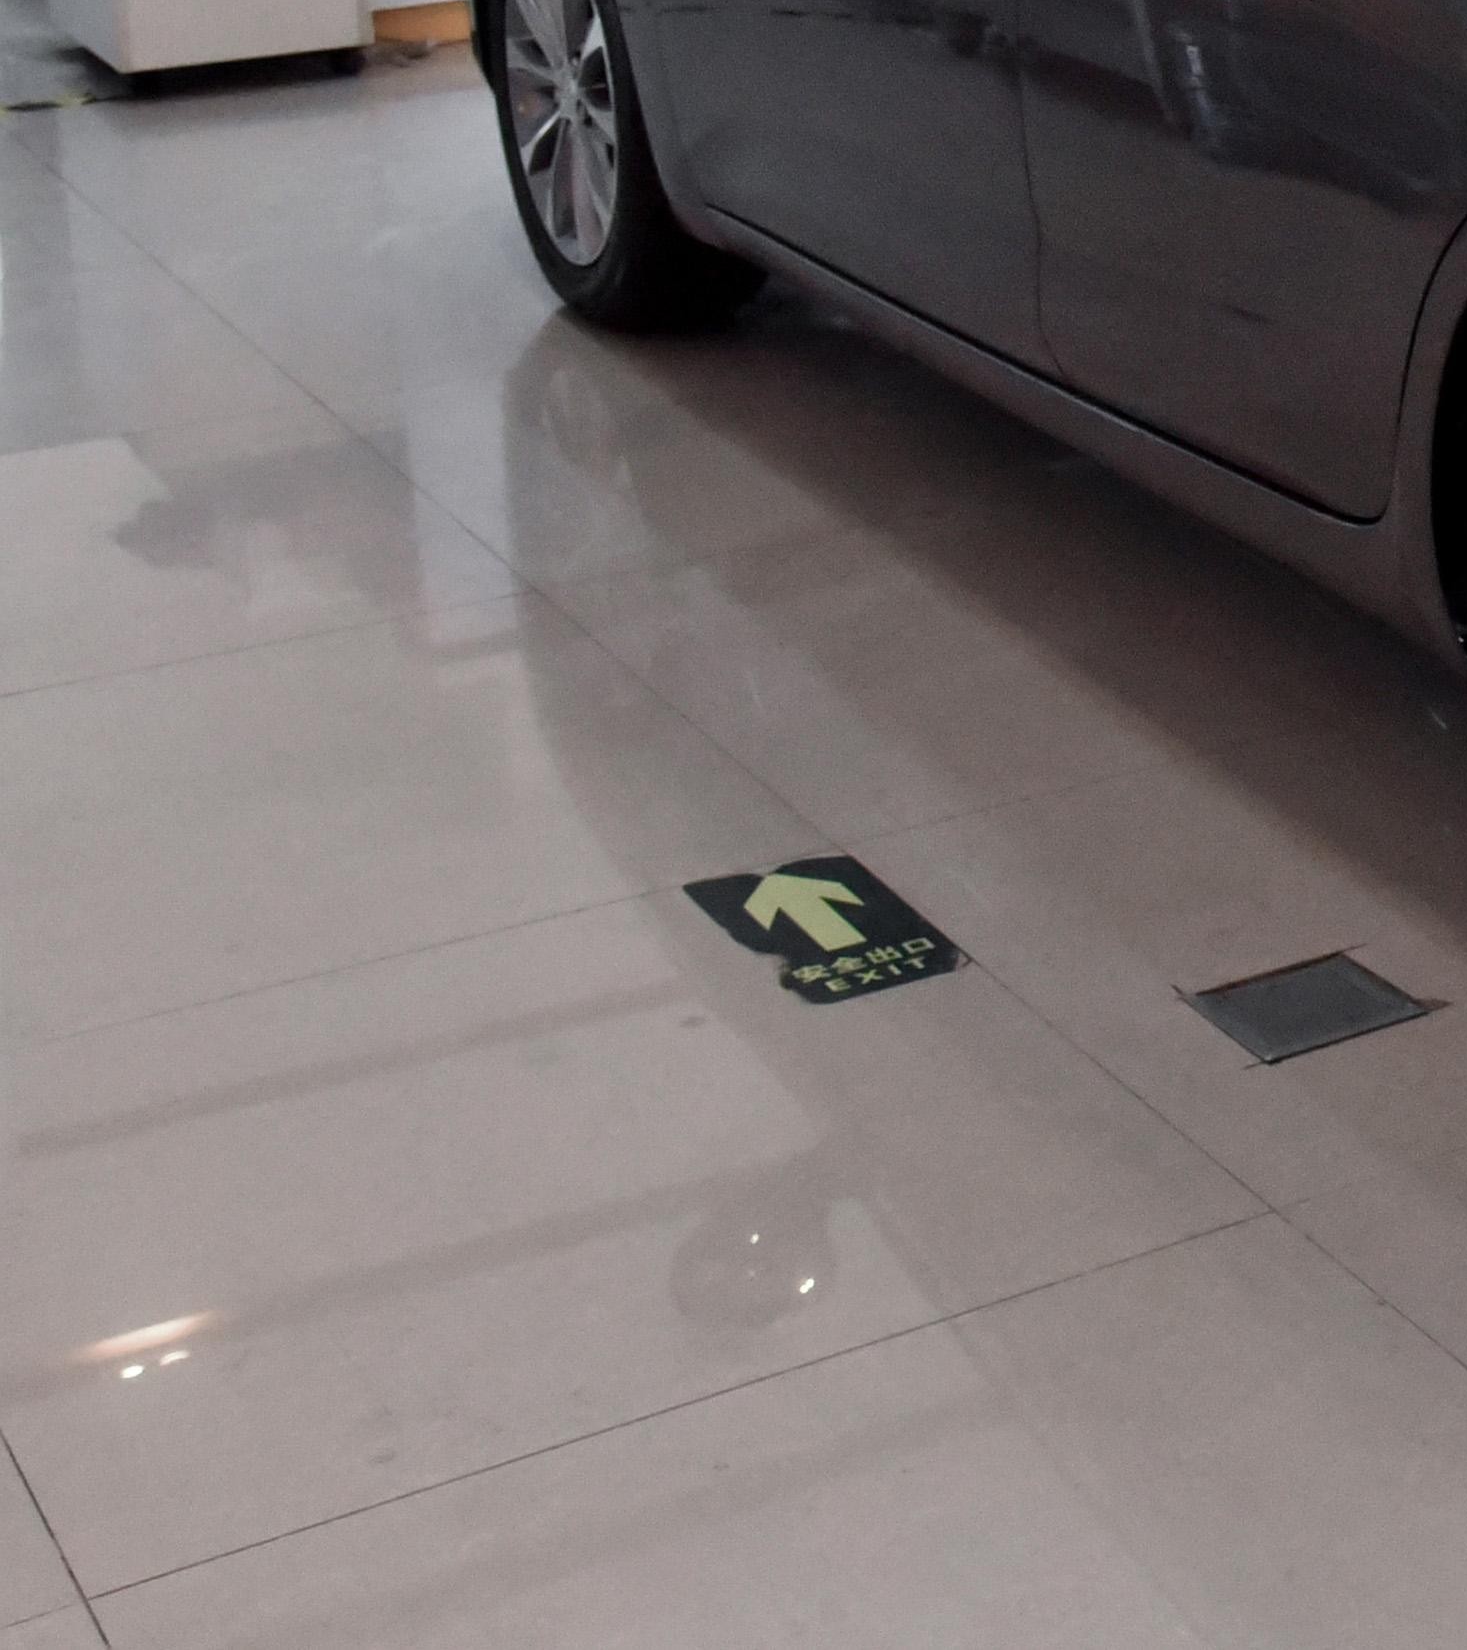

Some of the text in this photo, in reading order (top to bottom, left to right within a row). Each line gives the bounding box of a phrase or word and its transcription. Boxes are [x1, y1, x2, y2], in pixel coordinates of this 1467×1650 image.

[791, 937, 936, 984] 安全出口
[824, 955, 927, 993] EXIT
